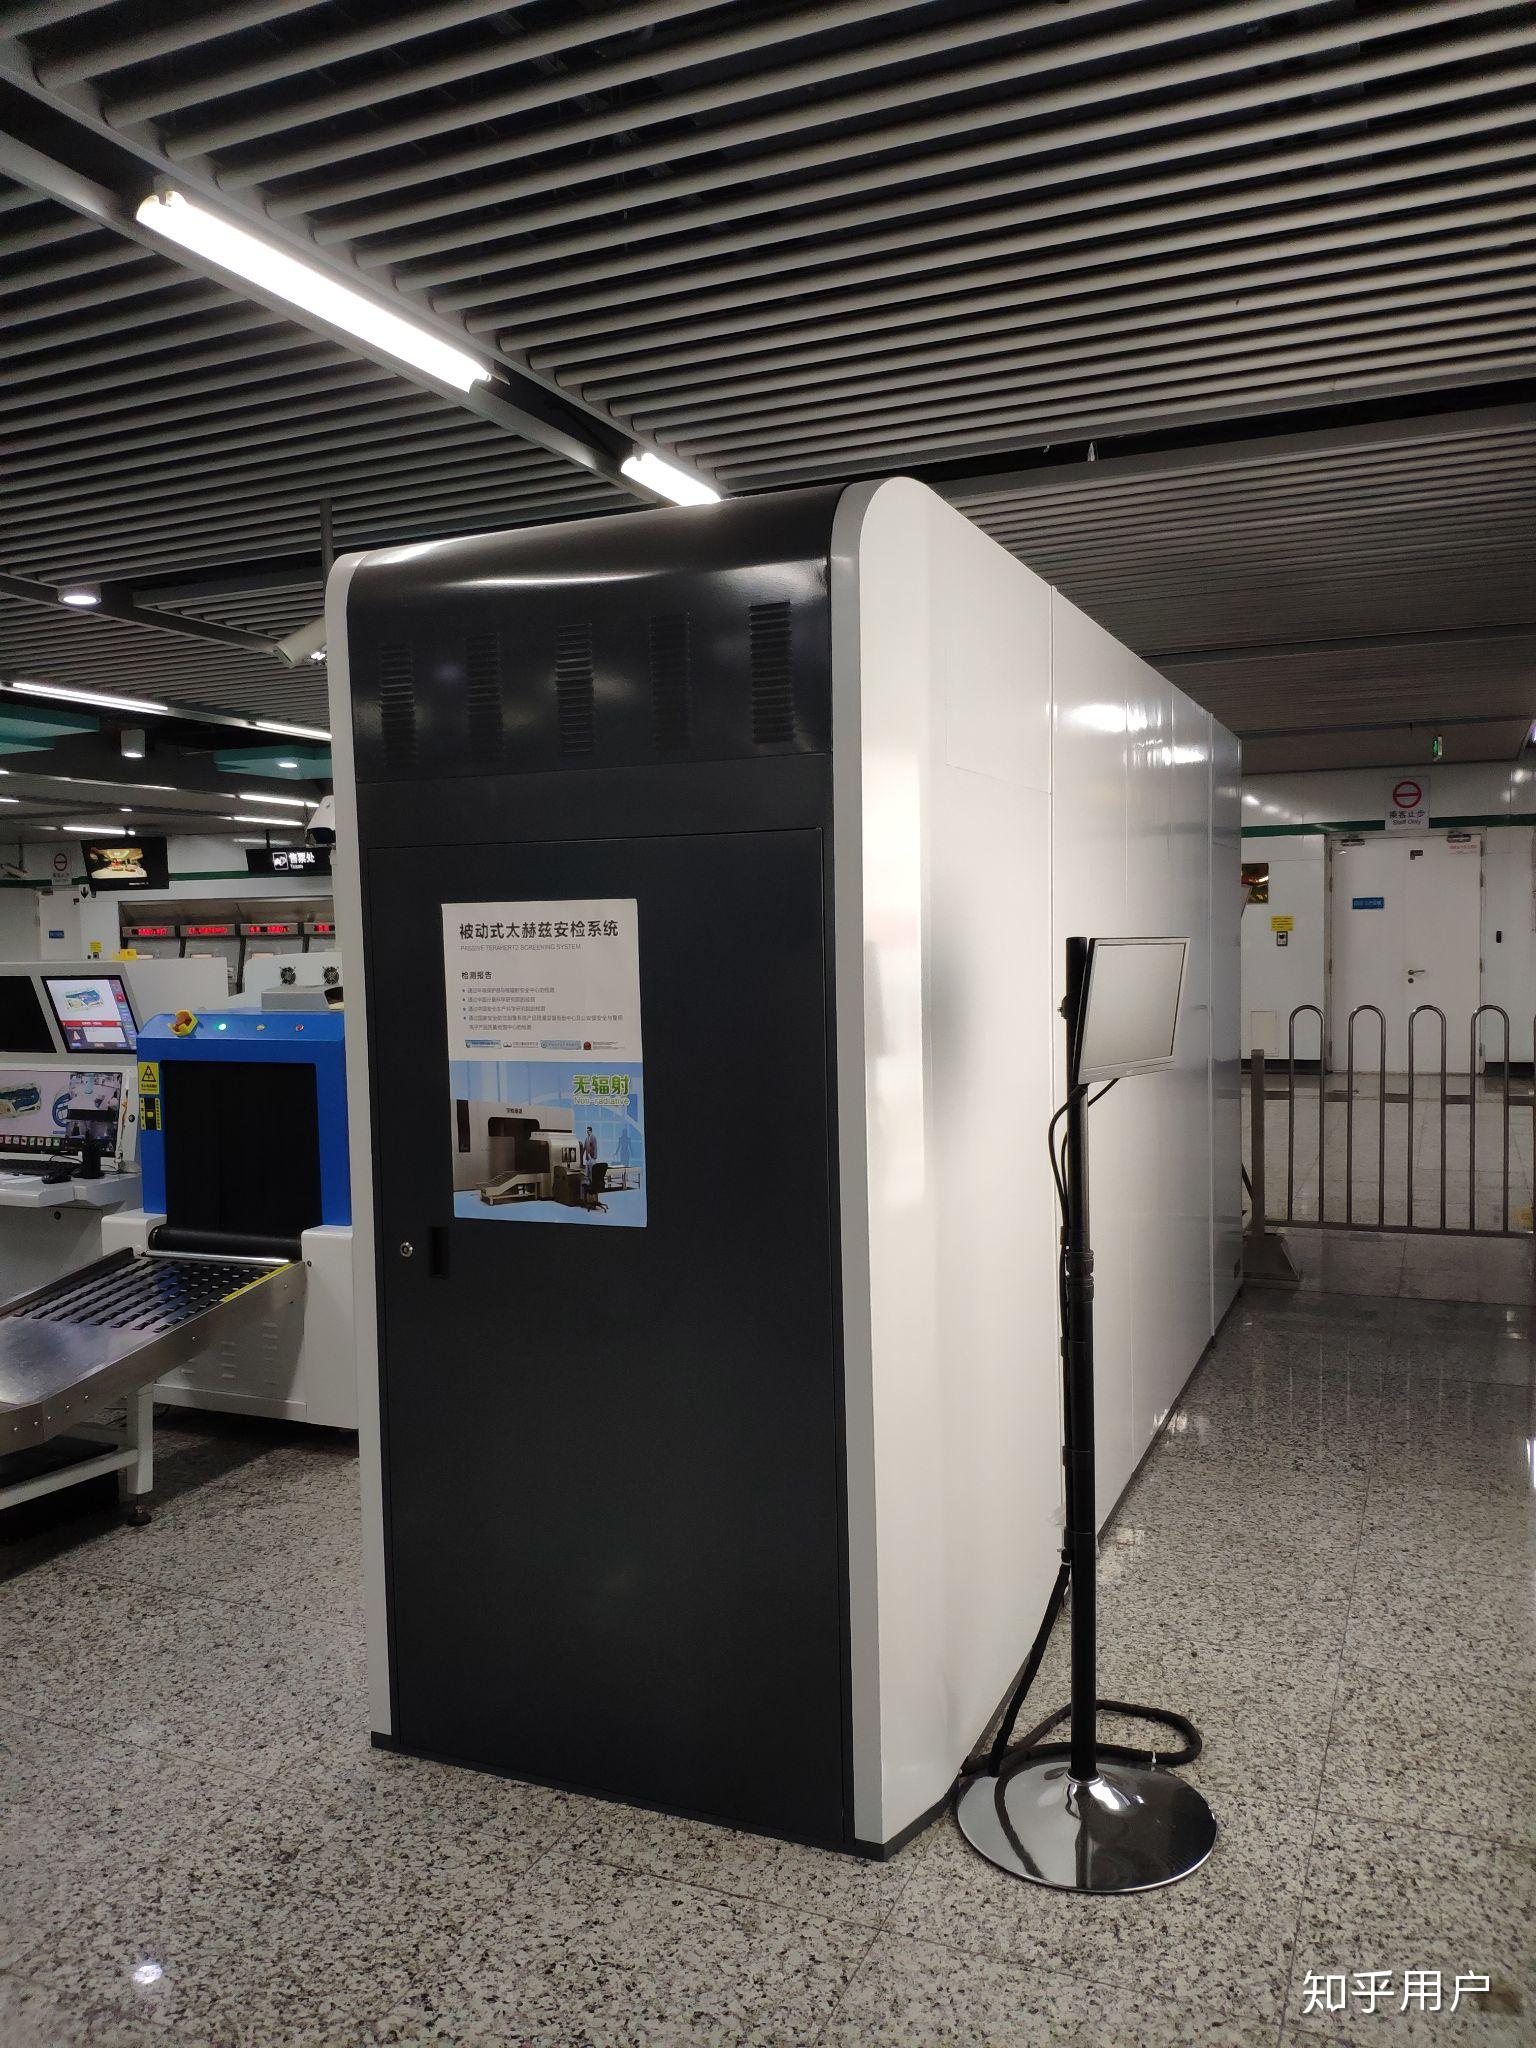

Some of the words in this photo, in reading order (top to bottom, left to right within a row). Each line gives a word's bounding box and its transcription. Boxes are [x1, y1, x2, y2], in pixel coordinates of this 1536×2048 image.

[459, 920, 618, 939] 被动式太赫兹安检系统
[462, 971, 492, 980] 检测报告
[573, 1075, 629, 1095] 无辐射
